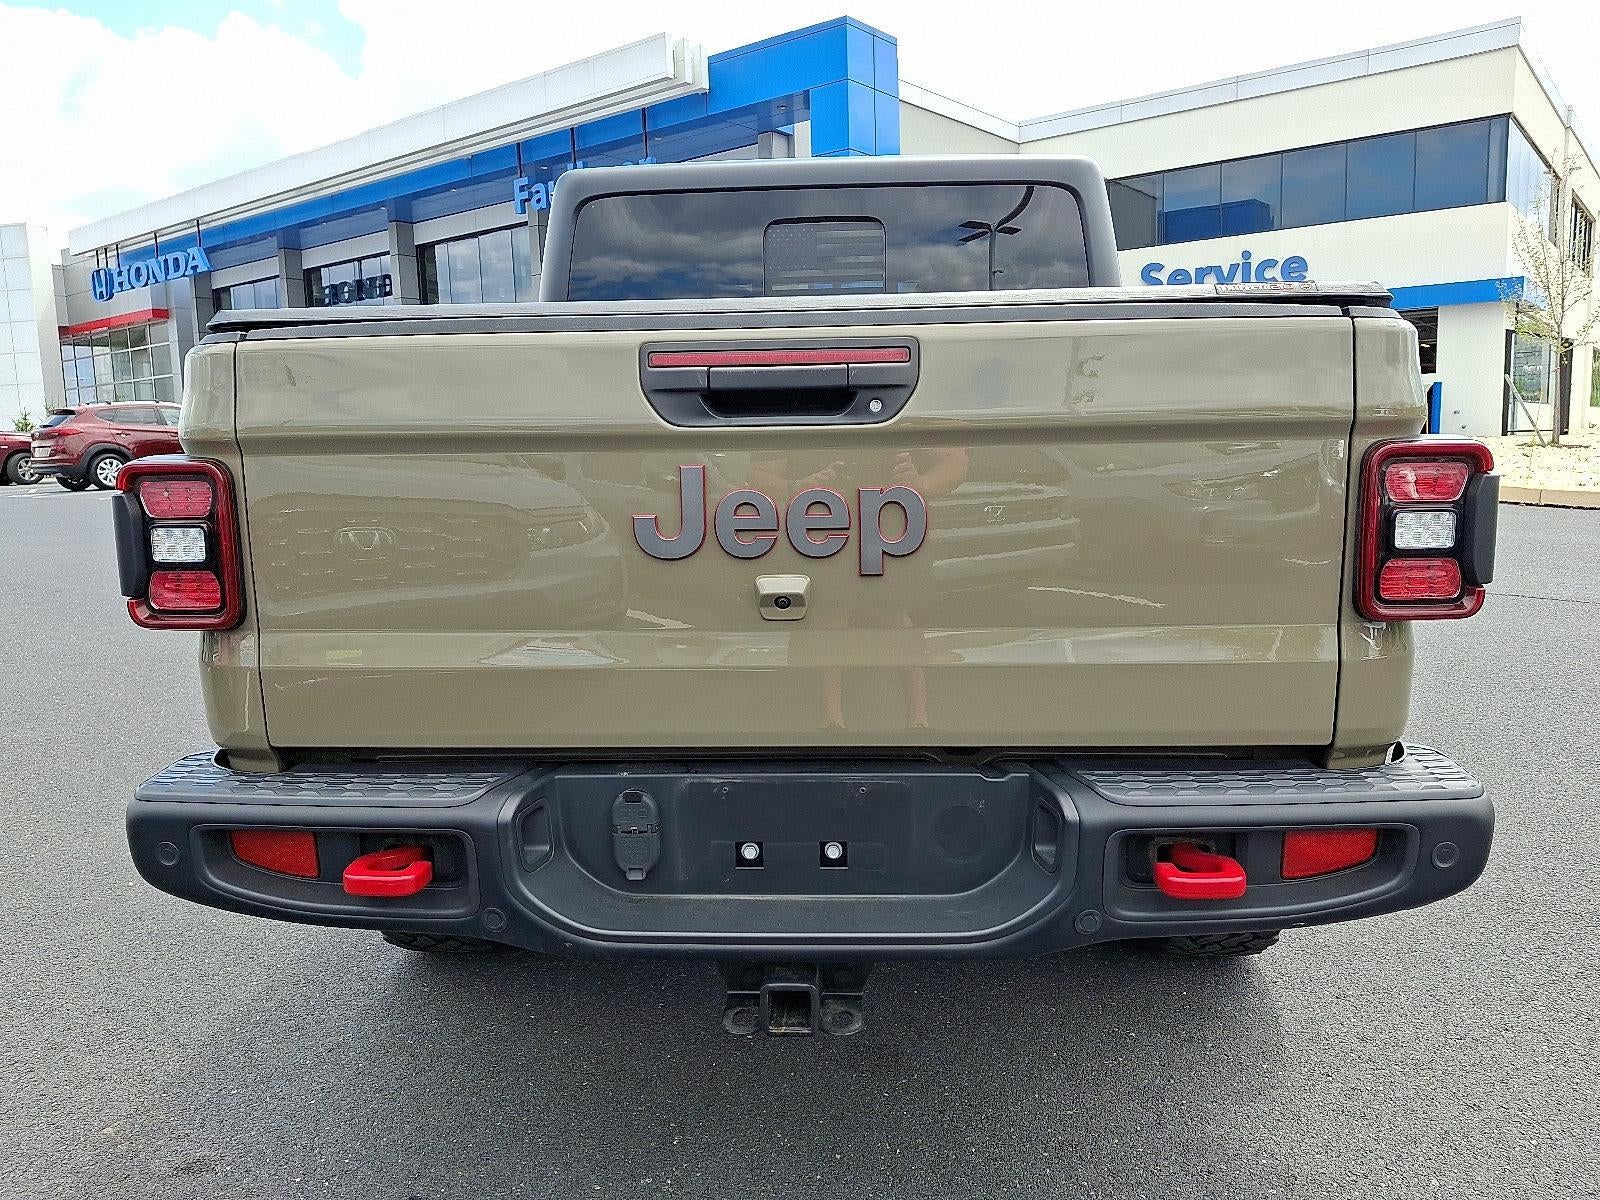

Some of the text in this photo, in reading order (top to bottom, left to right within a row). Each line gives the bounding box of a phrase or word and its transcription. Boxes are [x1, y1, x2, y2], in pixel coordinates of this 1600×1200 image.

[111, 246, 212, 293] HONDA
[1140, 250, 1309, 285] Service
[632, 464, 928, 577] Jeep
